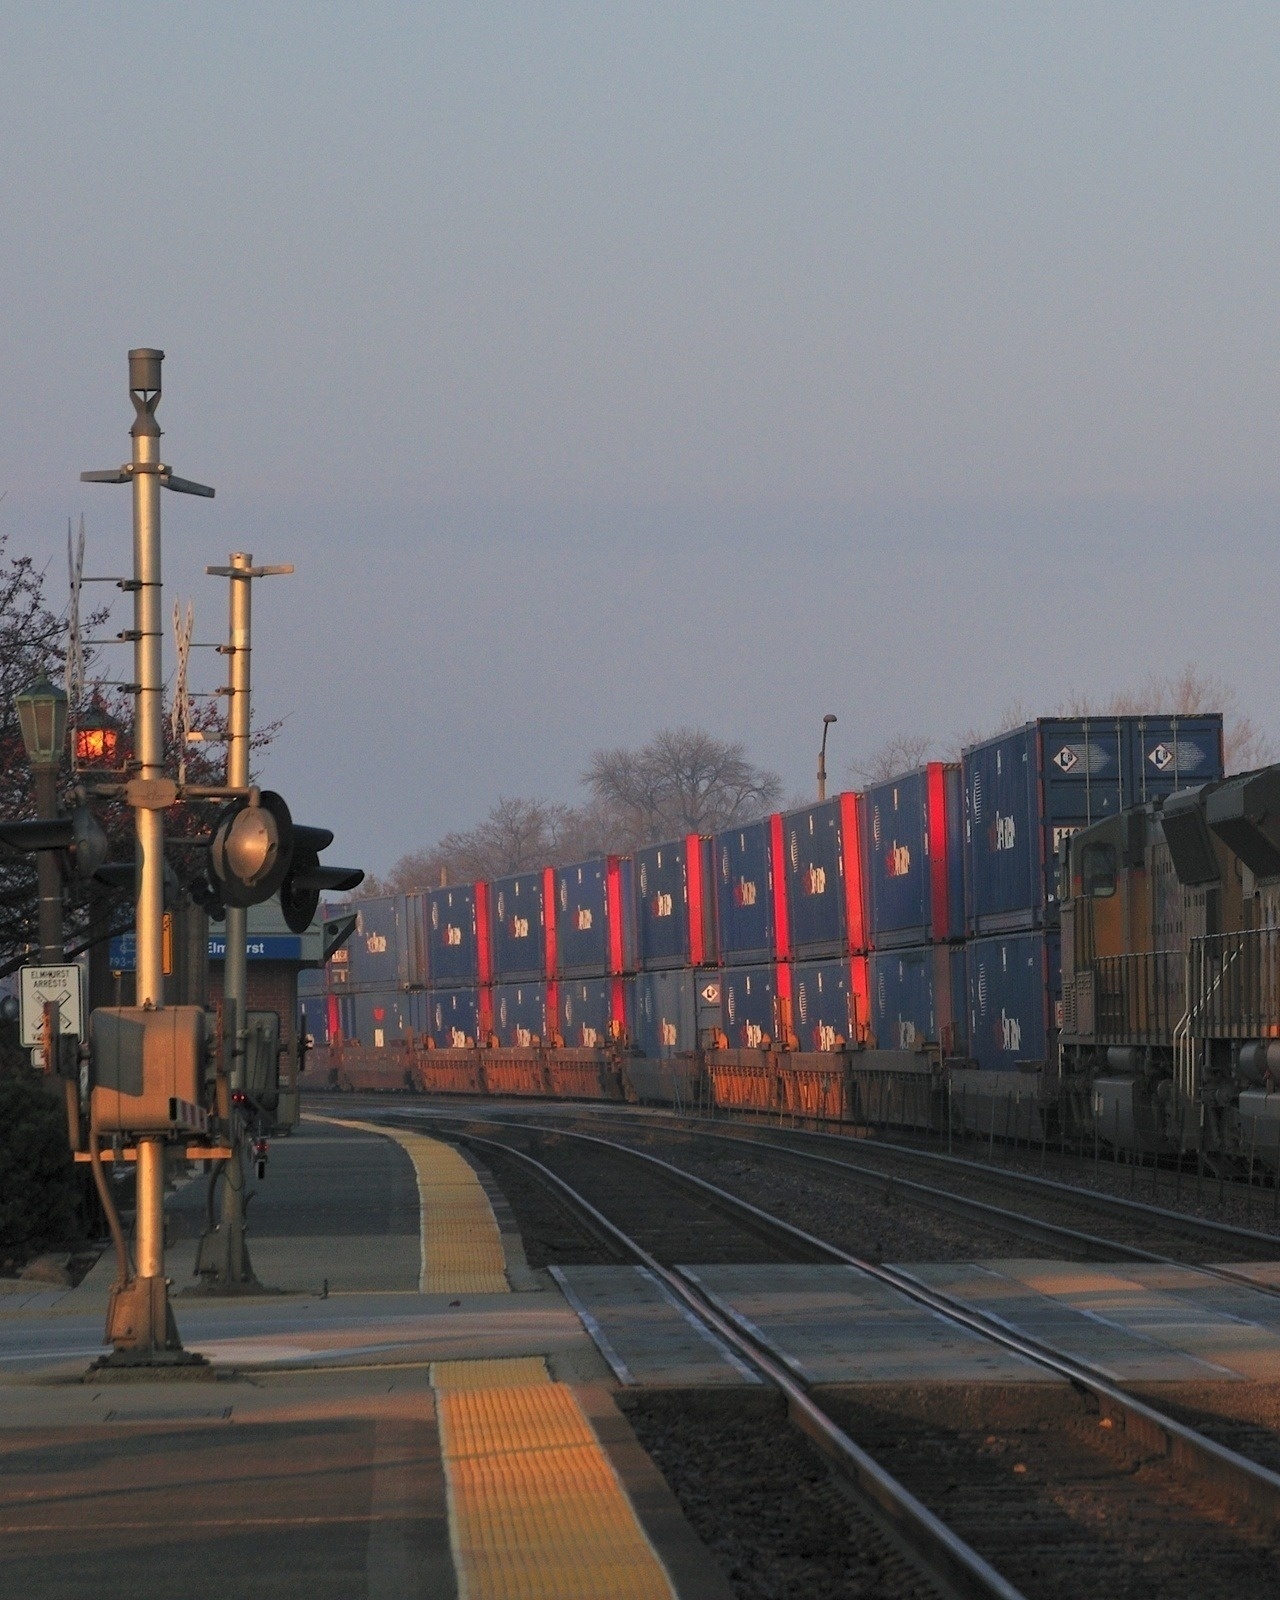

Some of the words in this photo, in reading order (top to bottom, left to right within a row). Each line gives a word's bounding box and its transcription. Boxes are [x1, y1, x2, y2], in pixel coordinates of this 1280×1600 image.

[208, 942, 264, 954] Elmrst
[31, 969, 70, 979] ELMHURST
[33, 979, 67, 988] ARRESTS
